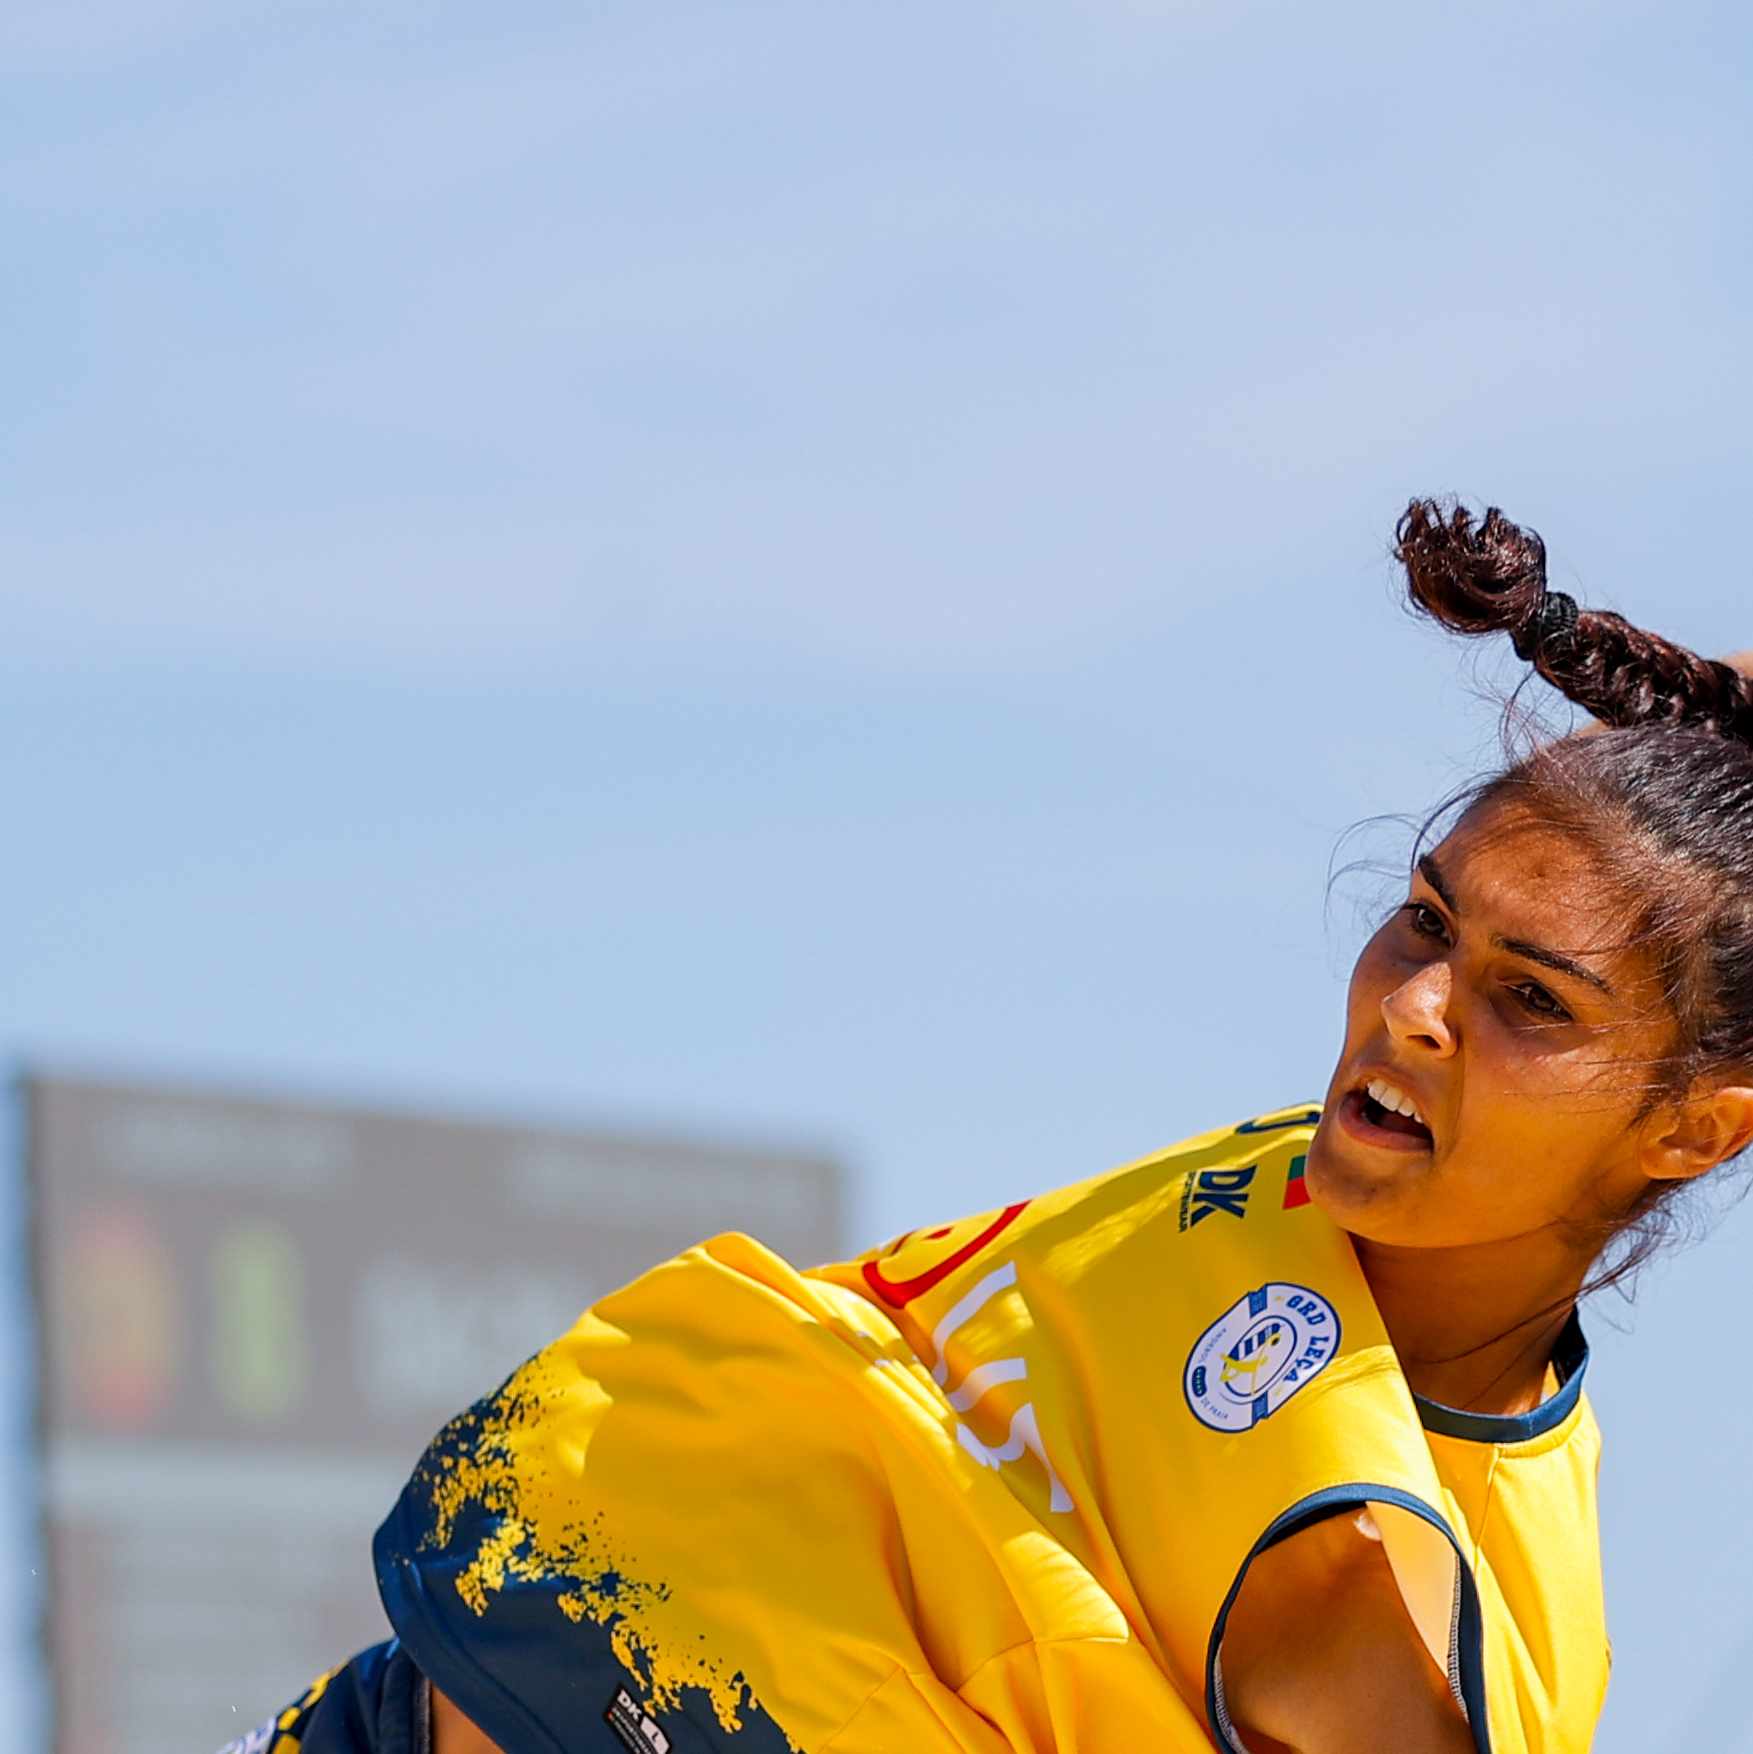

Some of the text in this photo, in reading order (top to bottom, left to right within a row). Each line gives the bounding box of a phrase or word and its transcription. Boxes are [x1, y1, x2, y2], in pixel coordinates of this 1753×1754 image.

[1190, 1165, 1258, 1227] DK
[1283, 1294, 1330, 1383] GRD LEÇA
[616, 1688, 643, 1722] DK
